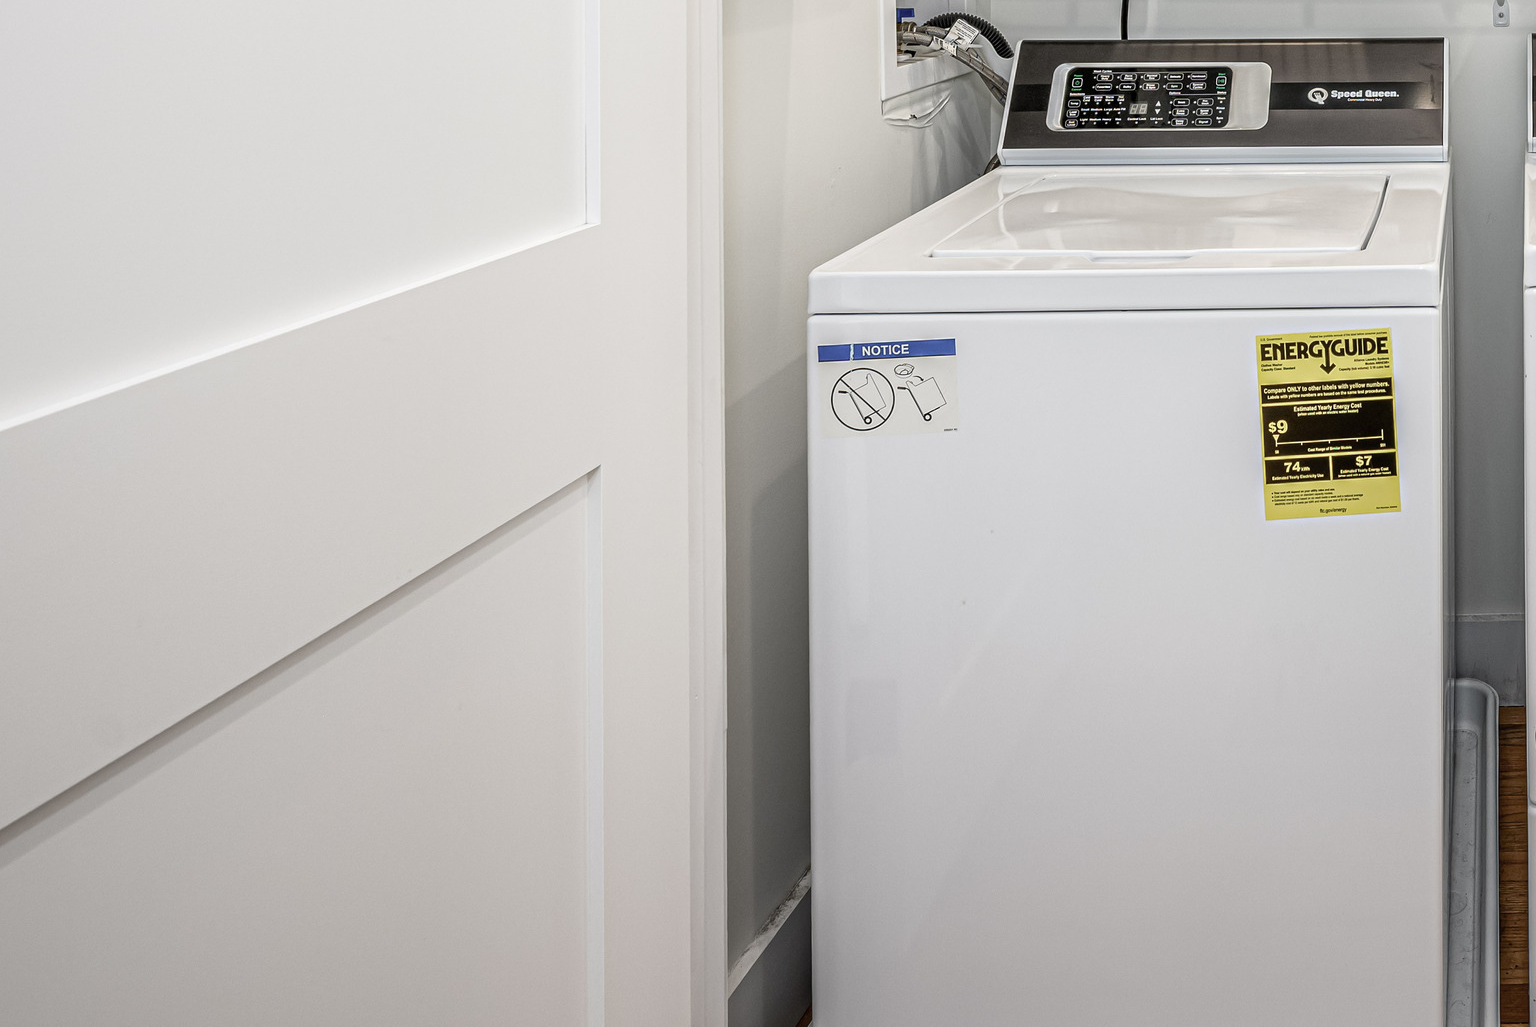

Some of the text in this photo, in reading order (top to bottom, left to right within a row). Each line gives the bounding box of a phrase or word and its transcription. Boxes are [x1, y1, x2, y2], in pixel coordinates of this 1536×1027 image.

[1331, 90, 1363, 99] Speed
[862, 344, 910, 356] NOTICE
[1260, 336, 1389, 362] ENERGYGUIDE
[1263, 387, 1287, 395] Compare
[1286, 385, 1301, 393] ONLY
[1349, 382, 1365, 390] yellow
[1268, 420, 1288, 434] $9
[1284, 461, 1300, 473] 74
[1355, 455, 1372, 467] $7
